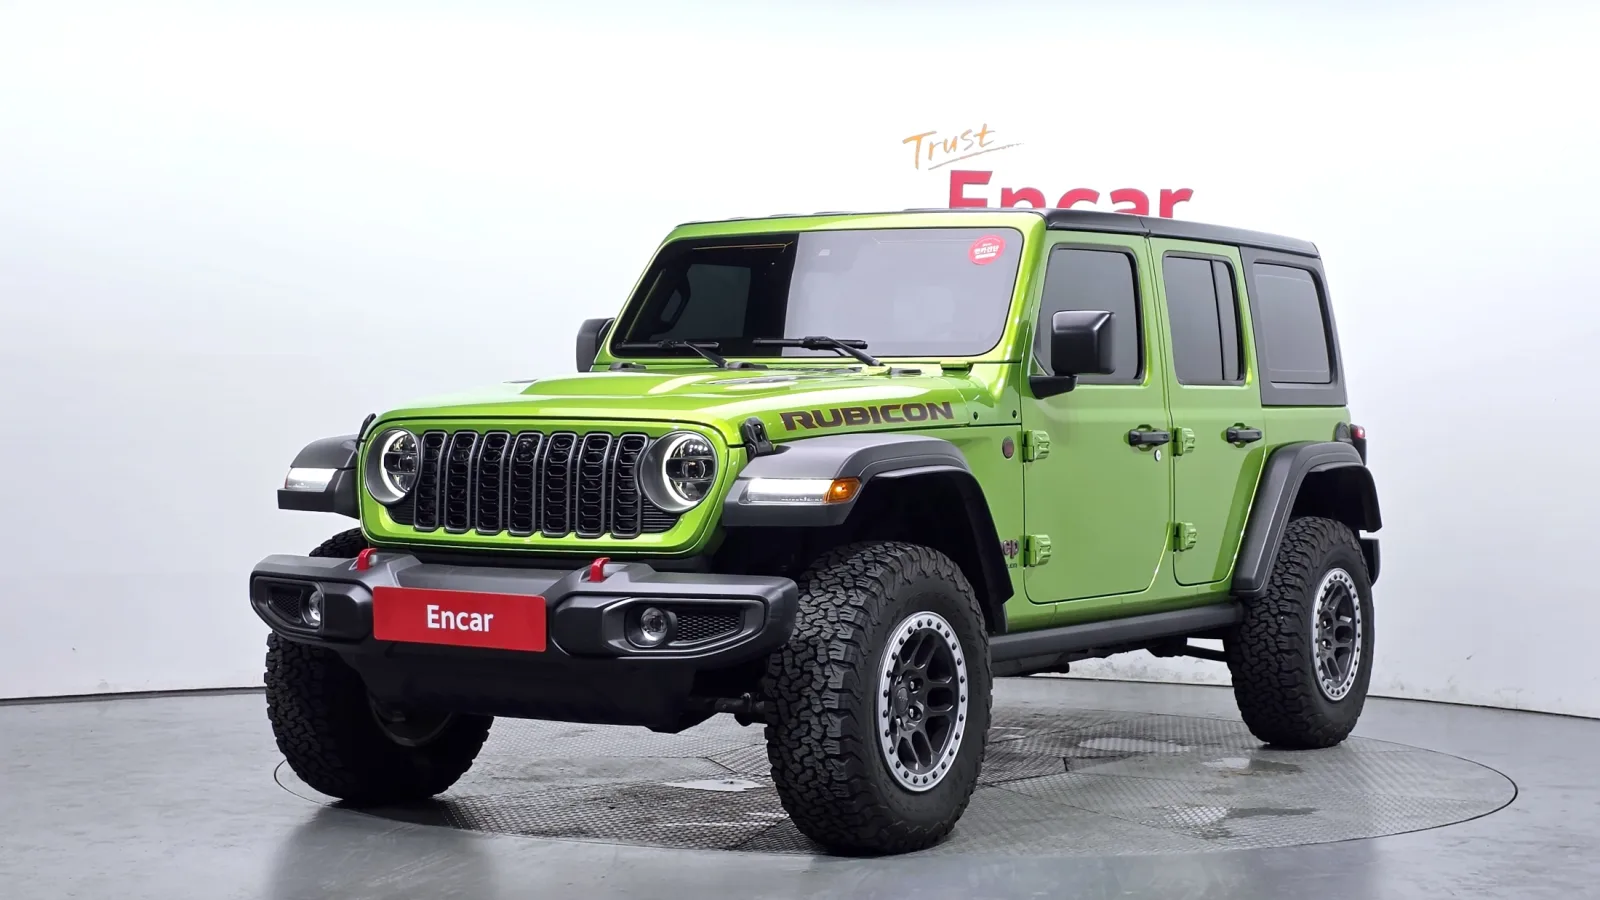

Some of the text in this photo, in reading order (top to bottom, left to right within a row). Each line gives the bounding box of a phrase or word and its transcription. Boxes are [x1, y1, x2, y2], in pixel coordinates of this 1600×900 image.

[902, 123, 996, 170] Trust
[779, 401, 954, 431] RUBICON
[426, 604, 494, 632] Encar
